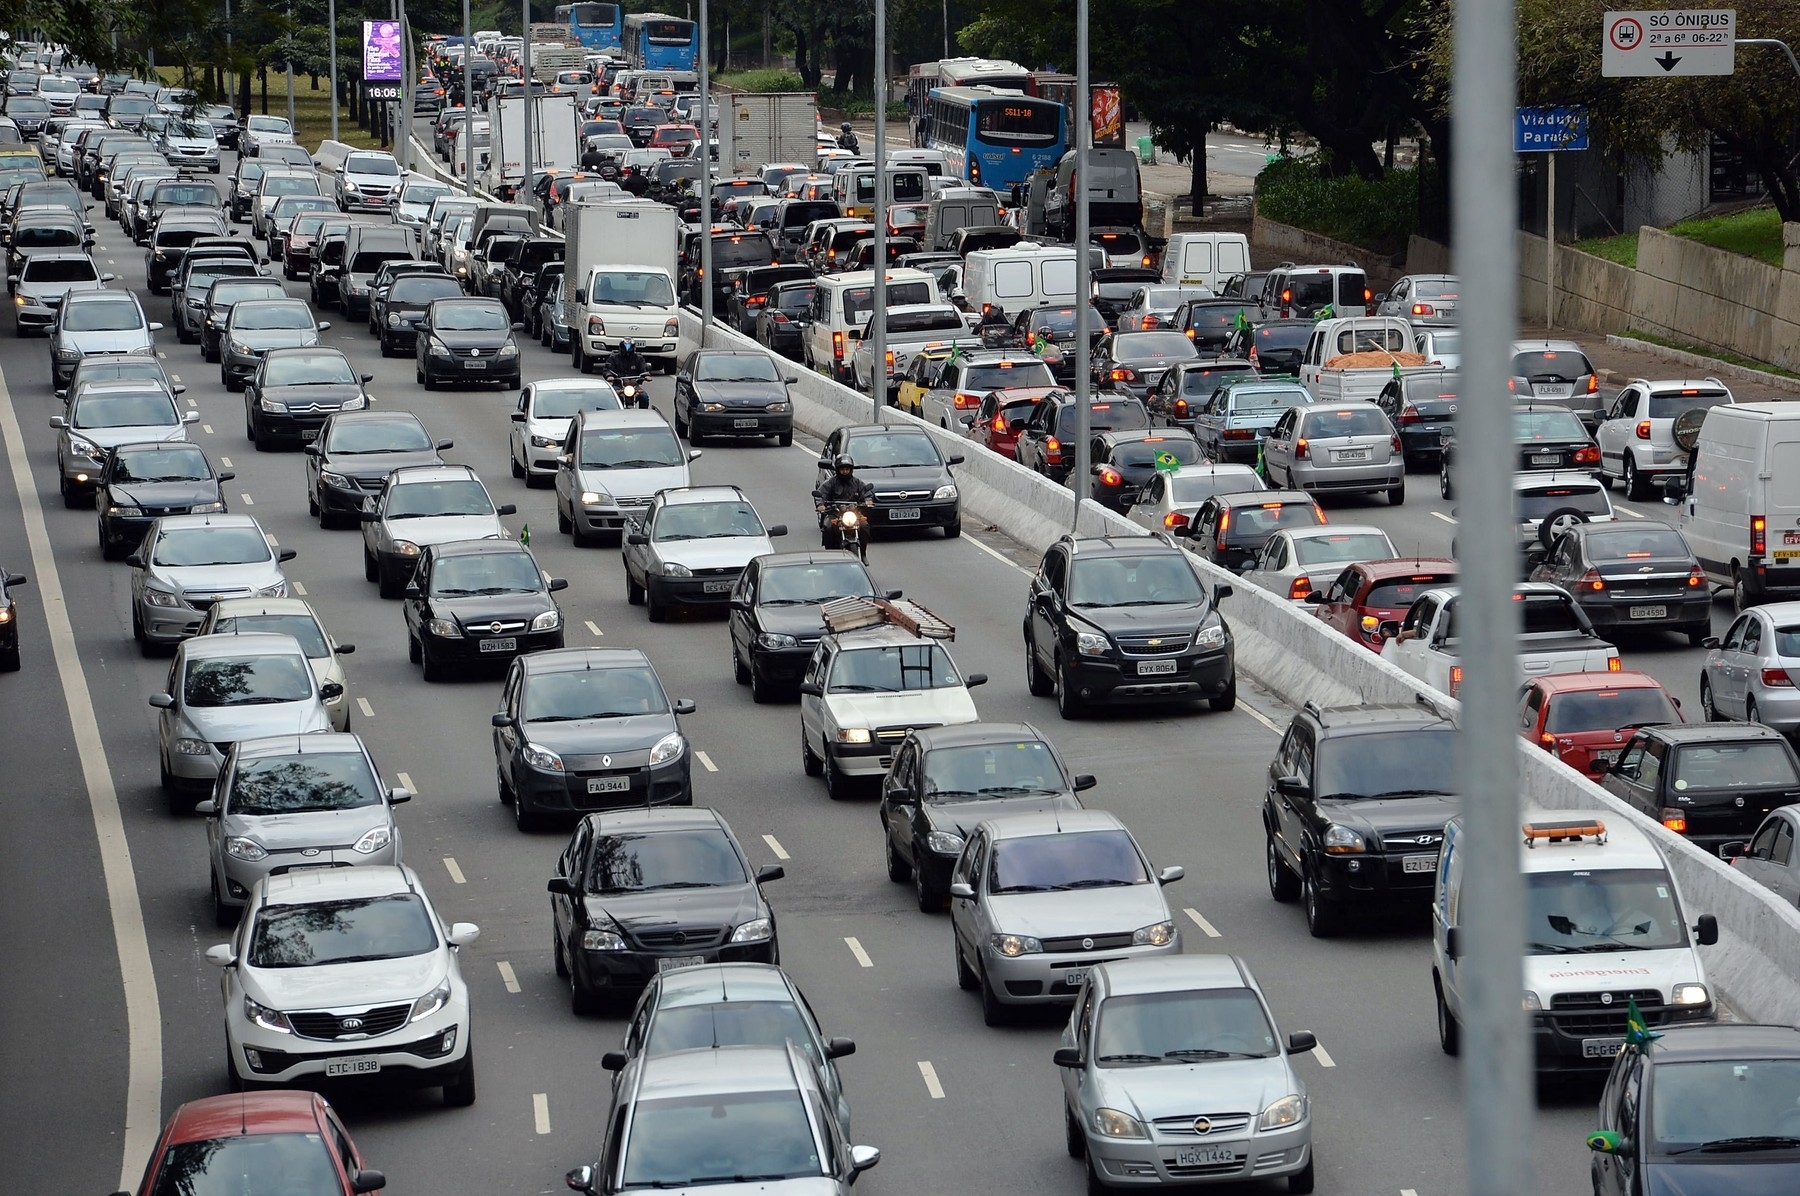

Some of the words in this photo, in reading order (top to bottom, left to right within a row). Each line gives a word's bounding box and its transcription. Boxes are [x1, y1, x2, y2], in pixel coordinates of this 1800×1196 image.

[1650, 12, 1669, 26] SÓ
[1675, 12, 1729, 26] ÔNIBUS
[369, 88, 397, 98] 16:06
[1521, 114, 1580, 126] Viaduto
[1523, 130, 1578, 143] Paraíso
[1405, 861, 1437, 871] EZI-79
[342, 1020, 360, 1028] KIA
